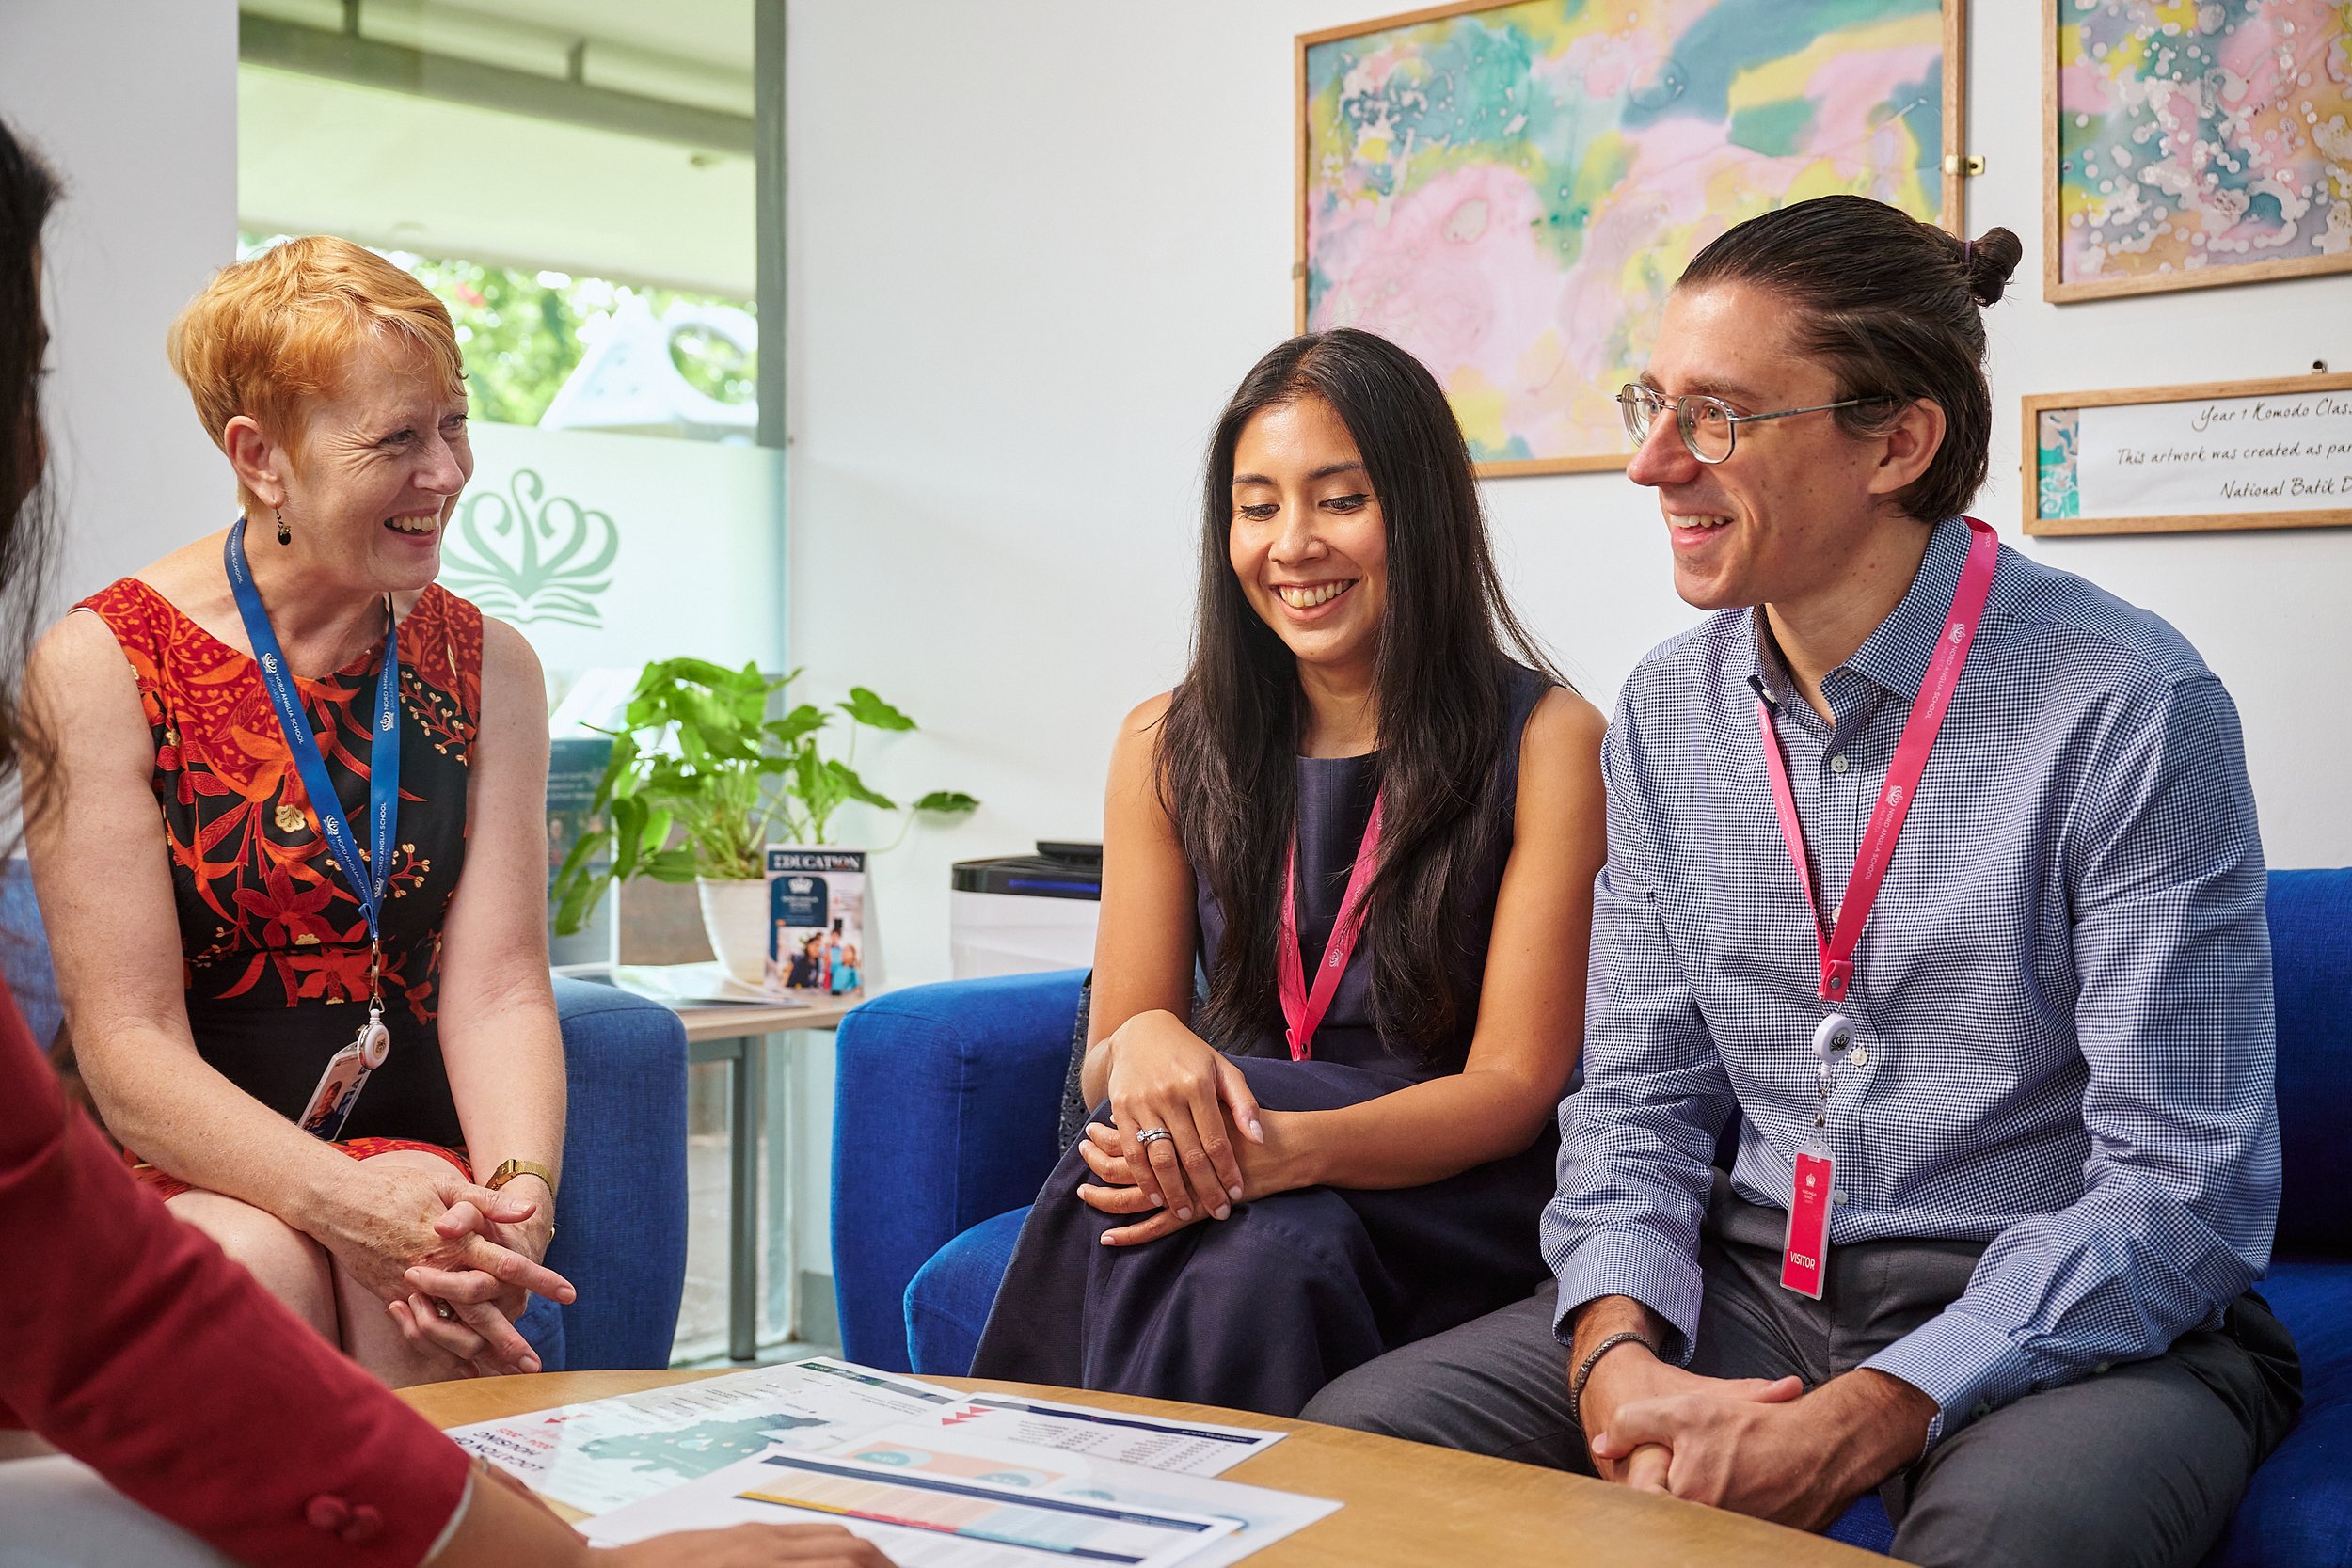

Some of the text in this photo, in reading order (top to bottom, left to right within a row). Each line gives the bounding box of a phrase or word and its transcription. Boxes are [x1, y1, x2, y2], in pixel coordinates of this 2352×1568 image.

[2191, 405, 2236, 432] Year
[2252, 401, 2309, 421] Komodo
[2315, 397, 2352, 417] Clas
[2117, 448, 2145, 465] This
[2151, 446, 2206, 463] artwork
[2212, 447, 2238, 460] was
[2243, 441, 2300, 459] created
[2306, 443, 2323, 455] as
[2220, 479, 2286, 498] National
[2291, 477, 2335, 496] Batik
[1925, 646, 1958, 720] NORD ANGLIA SCHOOL
[275, 673, 305, 745] NORD ANGLIA SCHOOL
[336, 835, 347, 855] NORD
[344, 855, 359, 879] ANGLIA
[1865, 807, 1895, 879] NORD ANGLIA SCHOOL
[1789, 1251, 1816, 1270] VISITOR
[470, 1445, 545, 1472] LOCATION
[473, 1431, 542, 1456] HOUSING
